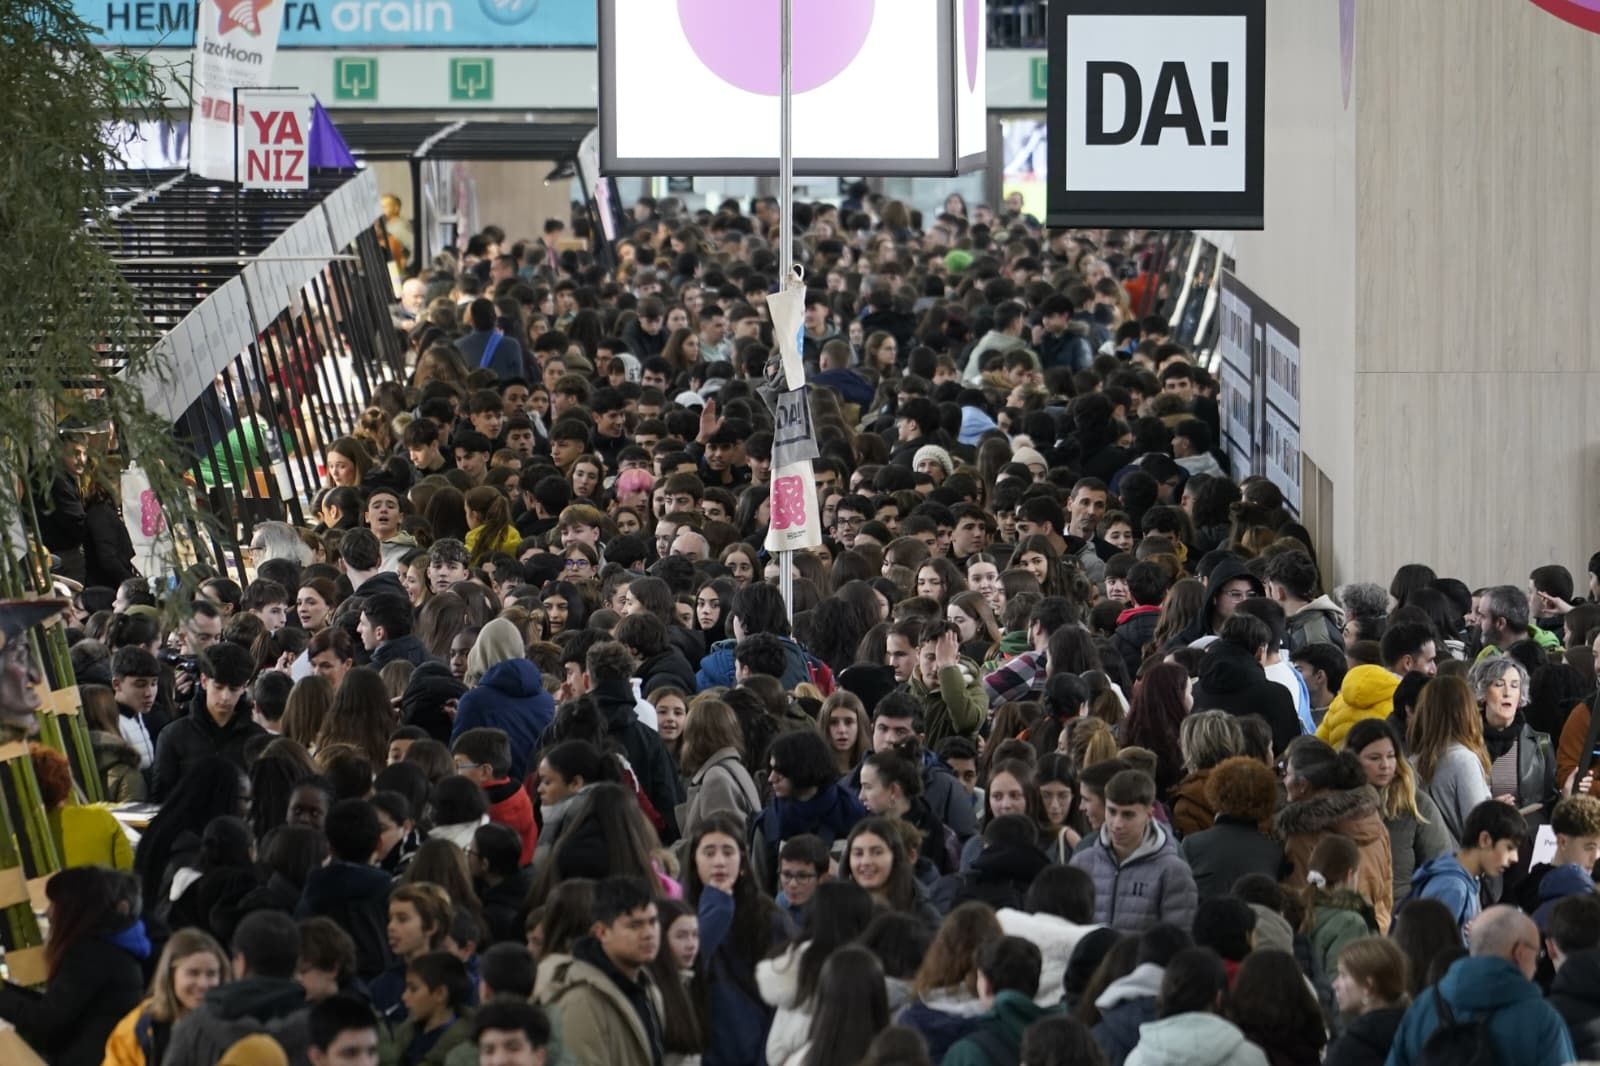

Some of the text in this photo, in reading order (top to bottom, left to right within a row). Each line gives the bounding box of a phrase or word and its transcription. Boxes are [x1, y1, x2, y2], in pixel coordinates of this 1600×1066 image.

[1085, 61, 1229, 146] DA!
[249, 111, 303, 144] YA
[248, 150, 304, 181] NIZ
[777, 401, 802, 429] DA!
